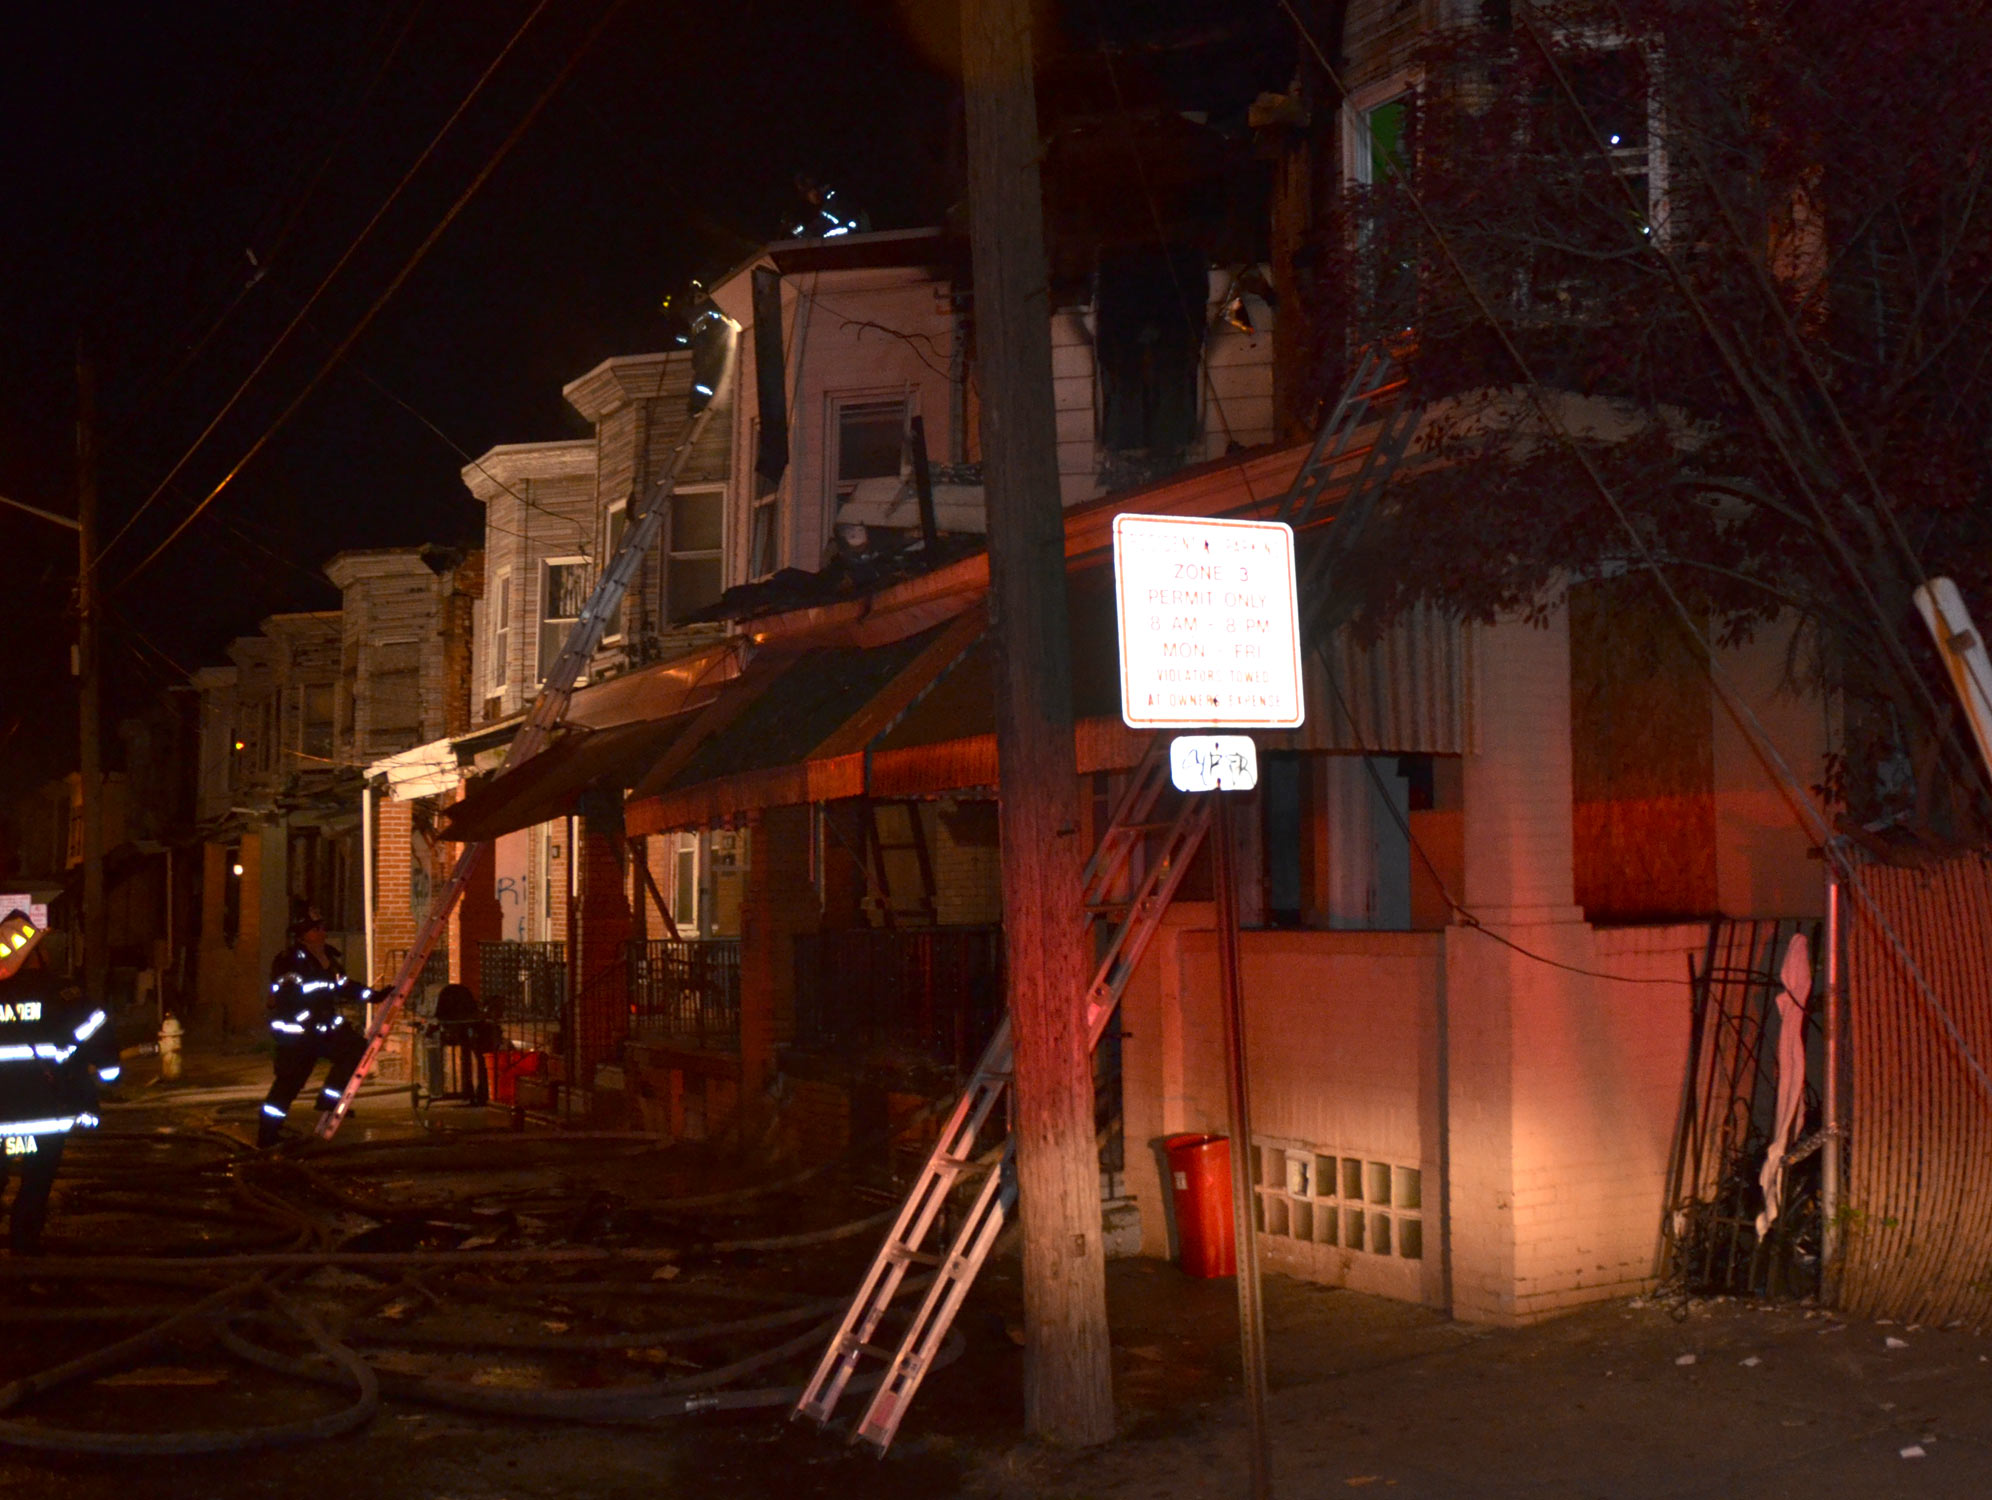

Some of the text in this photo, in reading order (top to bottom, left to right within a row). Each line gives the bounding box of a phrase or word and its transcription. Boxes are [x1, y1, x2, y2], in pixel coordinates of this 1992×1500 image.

[1174, 563, 1249, 582] ZONE 3
[1148, 589, 1267, 608] PERMIT ONLY
[1150, 615, 1161, 632] 8
[1172, 616, 1198, 631] AM
[1226, 617, 1236, 633] 8
[1246, 618, 1270, 633] PM
[1163, 642, 1205, 658] MON
[1235, 643, 1261, 659] FRI
[1229, 669, 1270, 684] TOWED
[1148, 693, 1161, 707] AT
